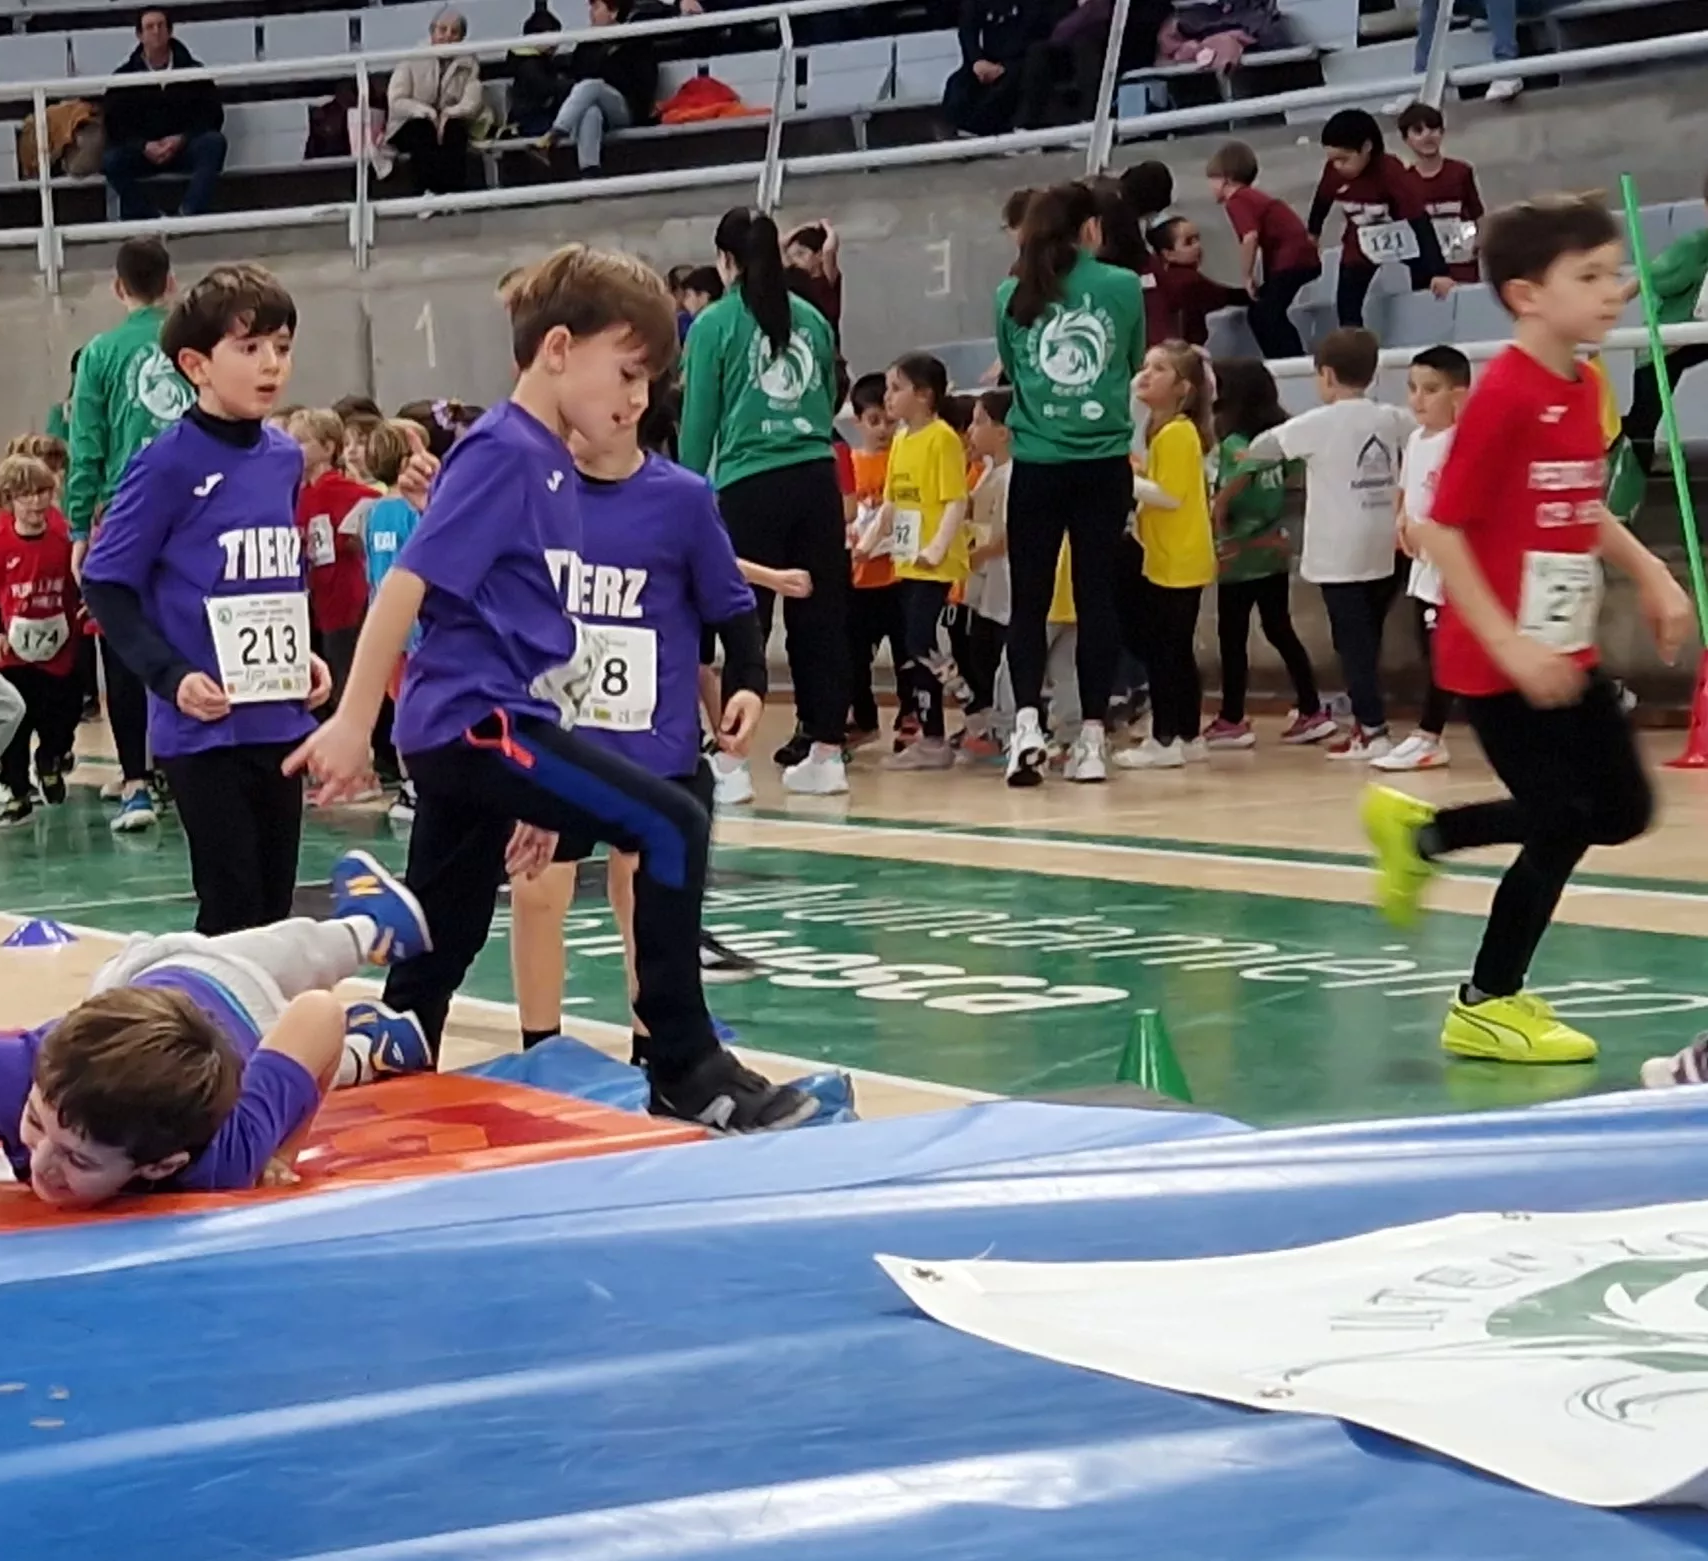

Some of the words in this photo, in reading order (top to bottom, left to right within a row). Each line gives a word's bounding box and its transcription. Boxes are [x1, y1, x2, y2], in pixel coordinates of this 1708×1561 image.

[544, 549, 648, 618] TIERZ
[22, 628, 60, 650] 174
[238, 625, 297, 666] 213
